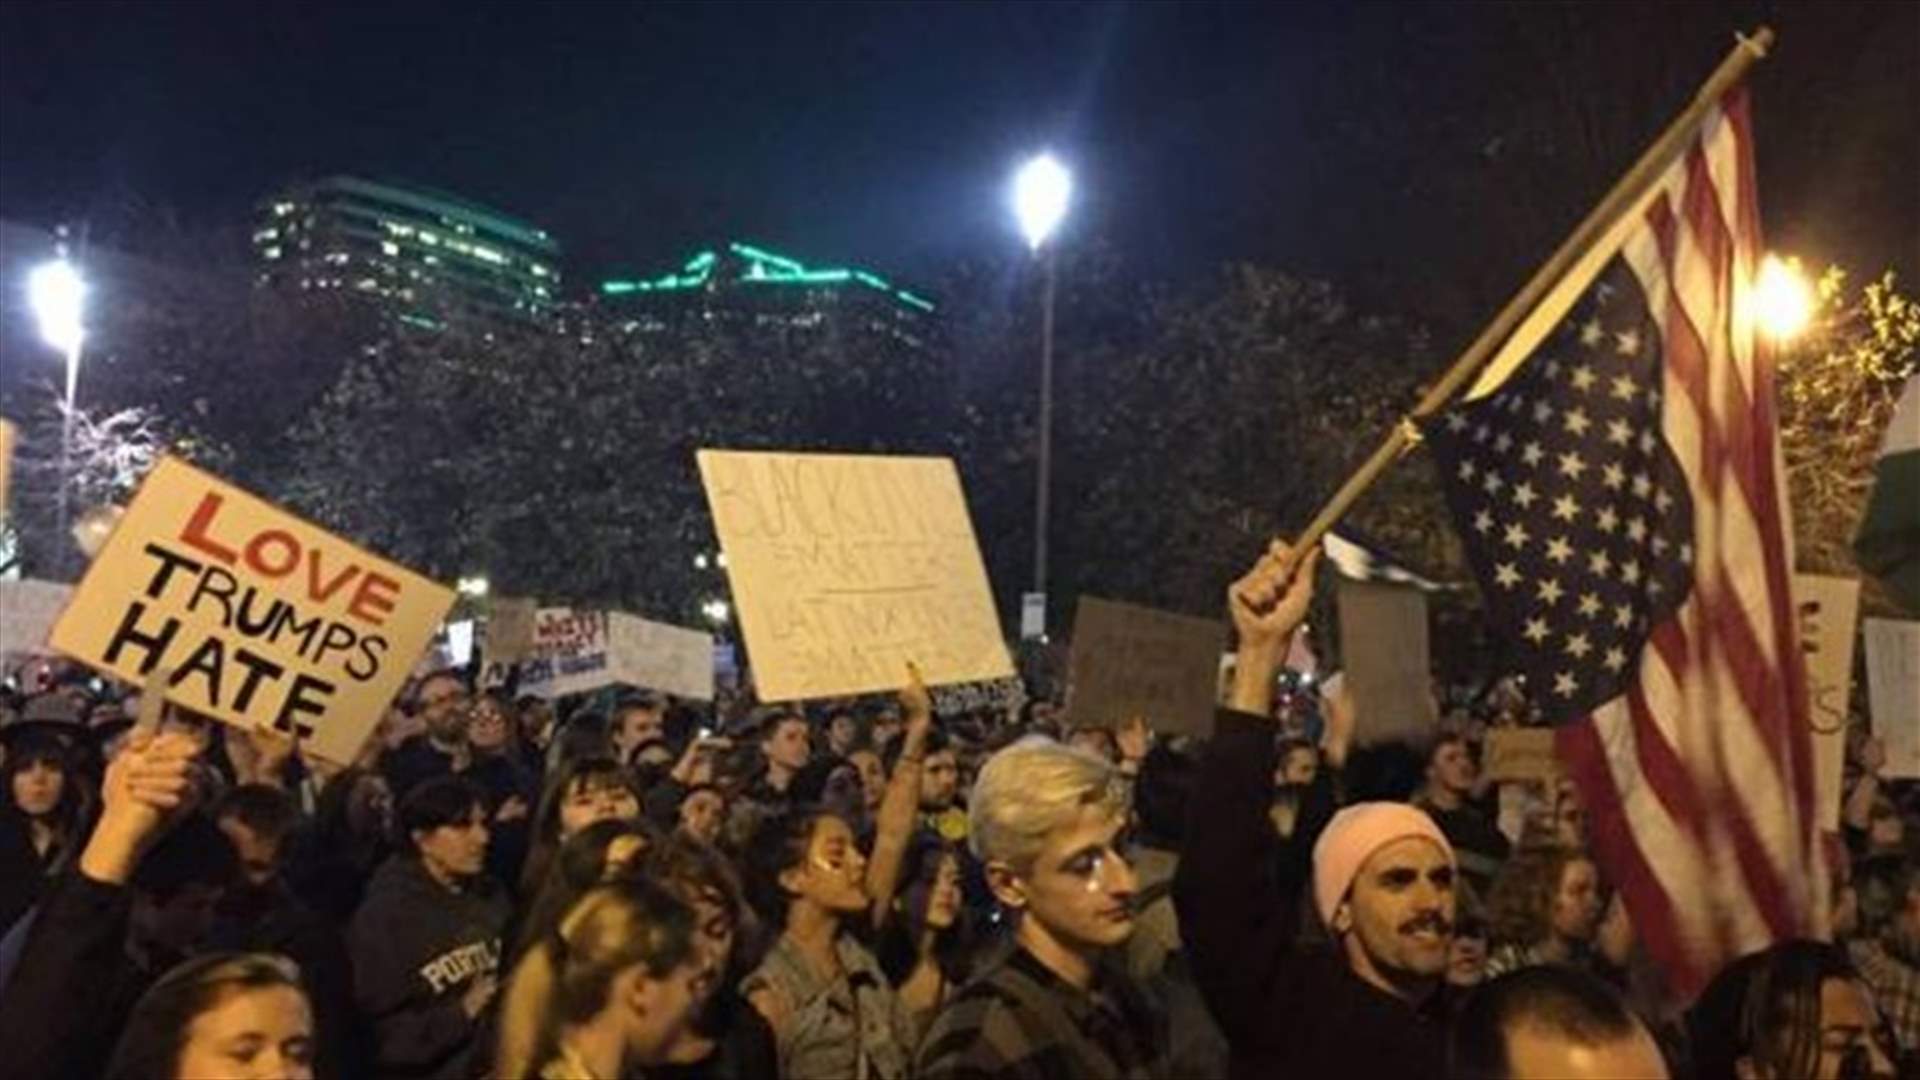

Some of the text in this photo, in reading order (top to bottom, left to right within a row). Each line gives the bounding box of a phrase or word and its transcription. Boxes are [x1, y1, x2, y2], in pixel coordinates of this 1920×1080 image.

[144, 543, 389, 682] TRUMPS
[178, 491, 401, 627] LOVE
[102, 602, 336, 740] HATE
